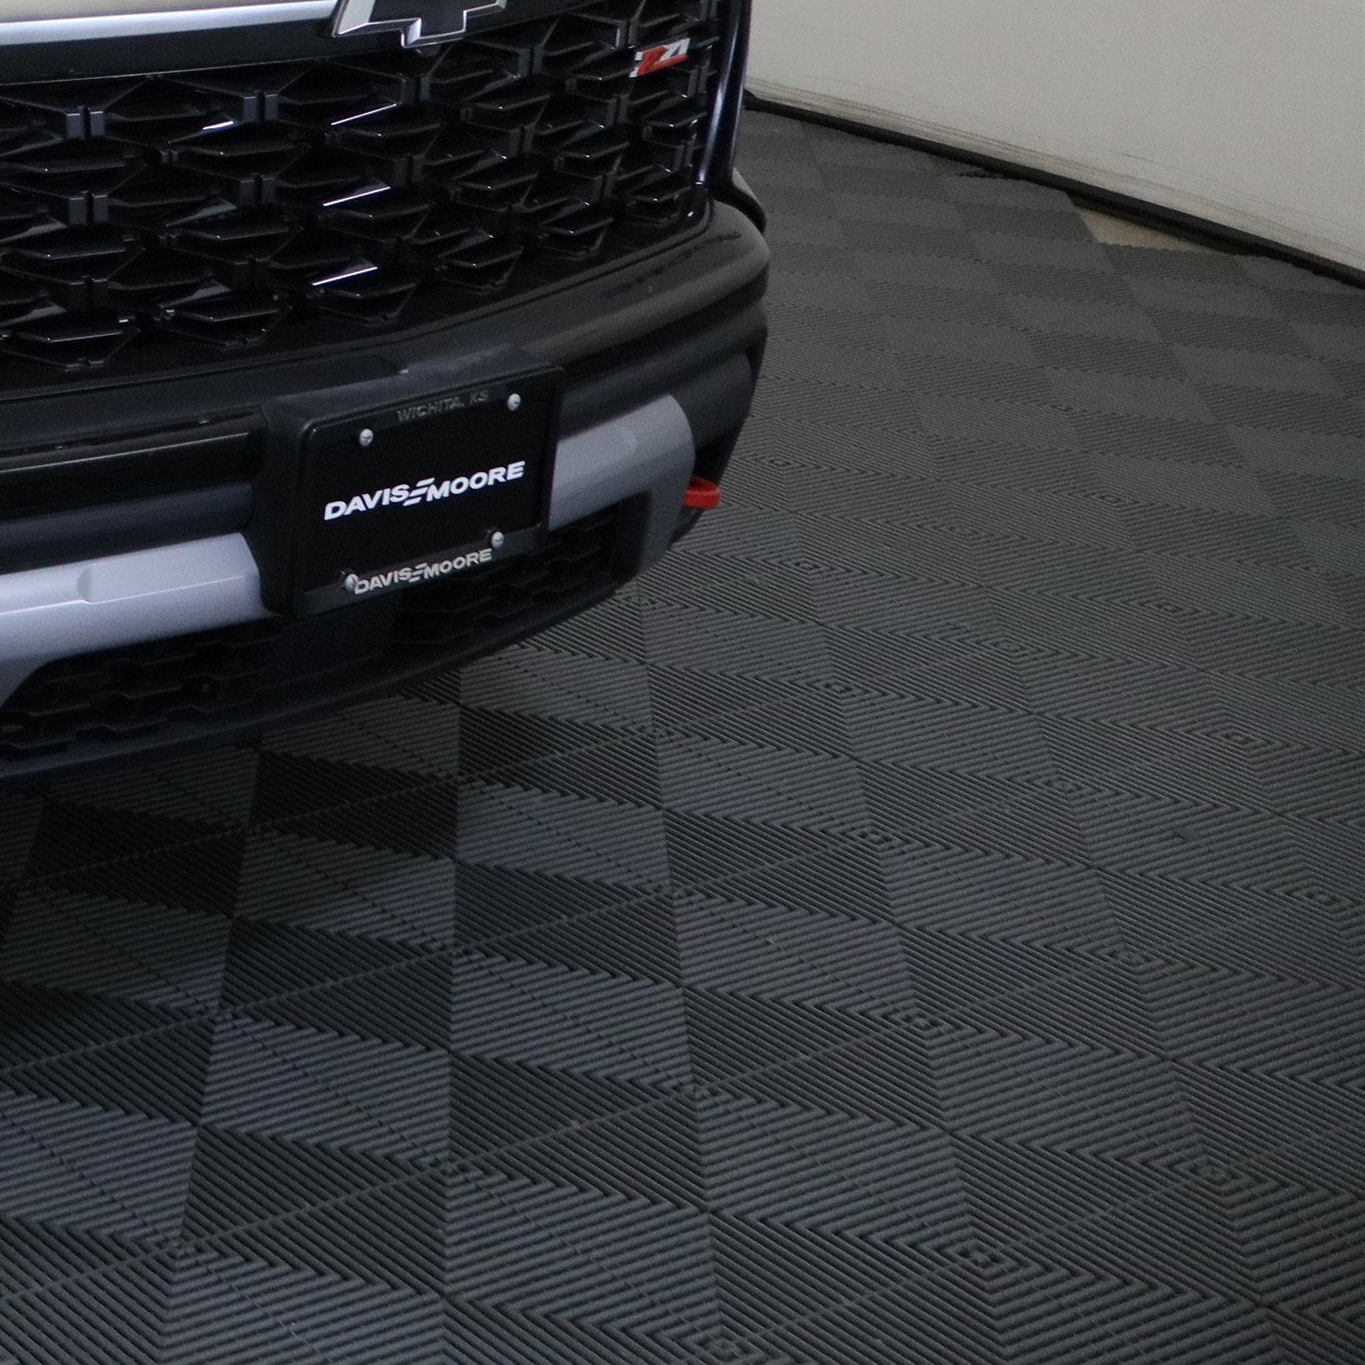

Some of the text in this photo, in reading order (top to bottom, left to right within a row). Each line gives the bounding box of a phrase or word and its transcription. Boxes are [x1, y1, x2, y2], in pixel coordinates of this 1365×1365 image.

[323, 460, 526, 521] DAVIS MOORE
[354, 547, 493, 595] DAVIS MOORE
